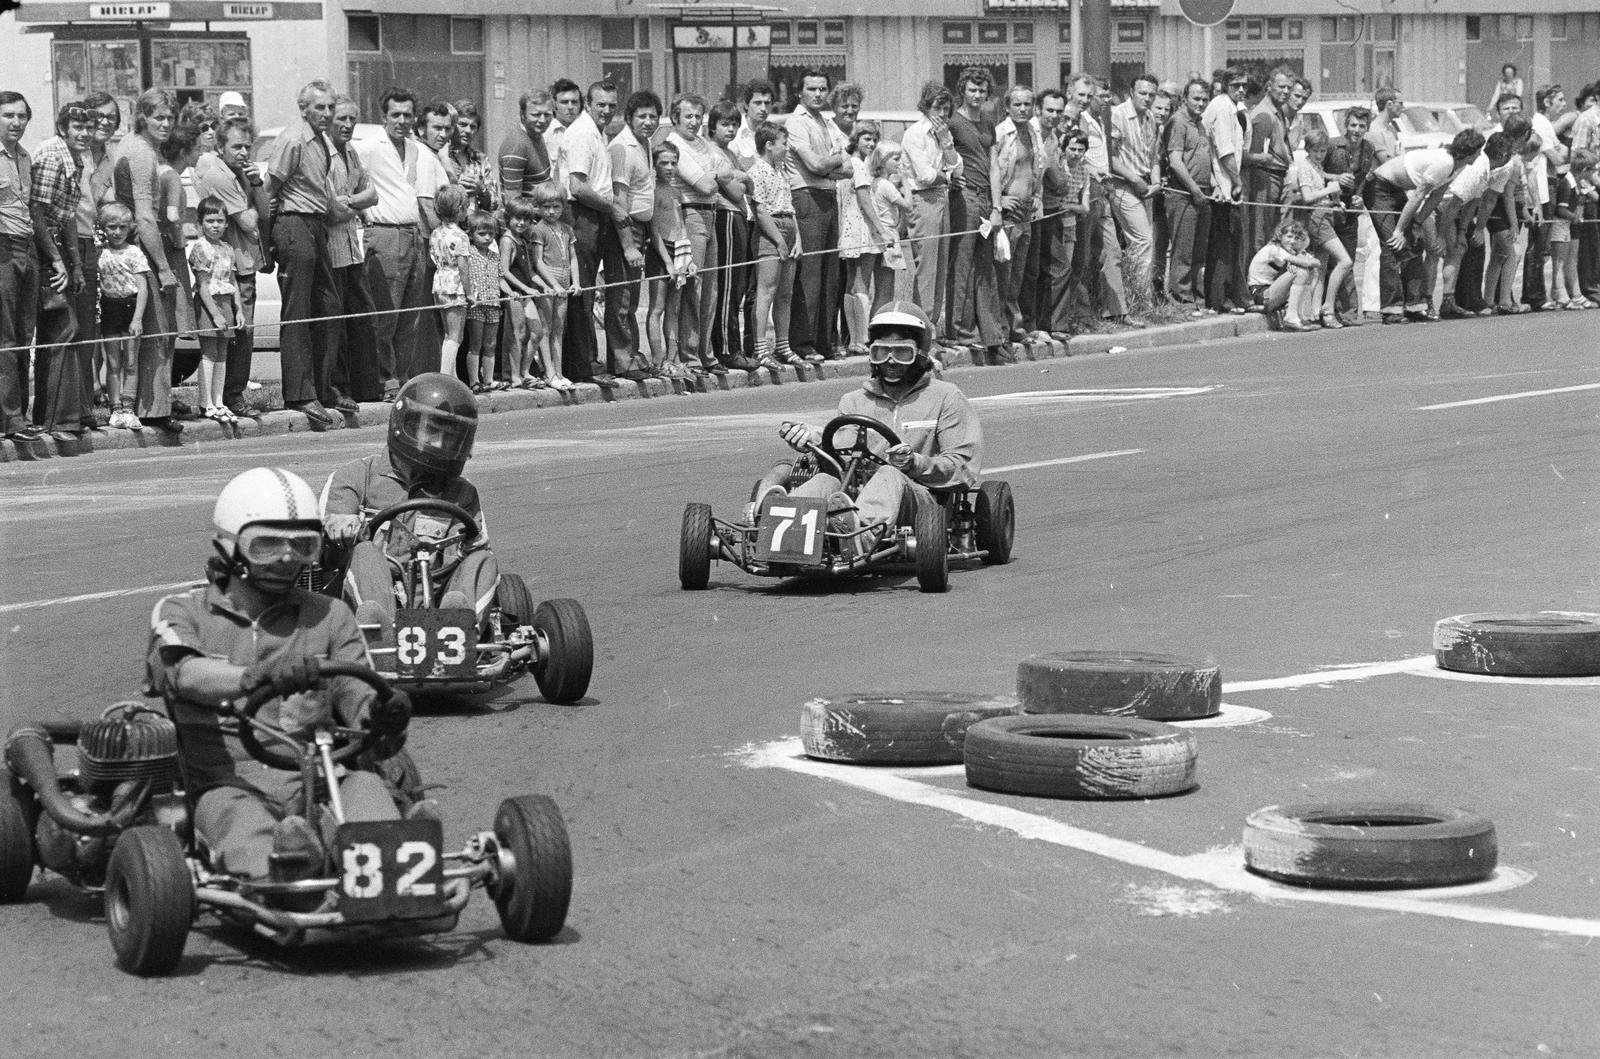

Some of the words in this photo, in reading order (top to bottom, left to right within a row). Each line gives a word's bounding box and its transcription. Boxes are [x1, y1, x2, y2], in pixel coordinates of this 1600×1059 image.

[769, 506, 818, 555] 71
[397, 626, 466, 665] 83
[342, 841, 437, 898] 82
